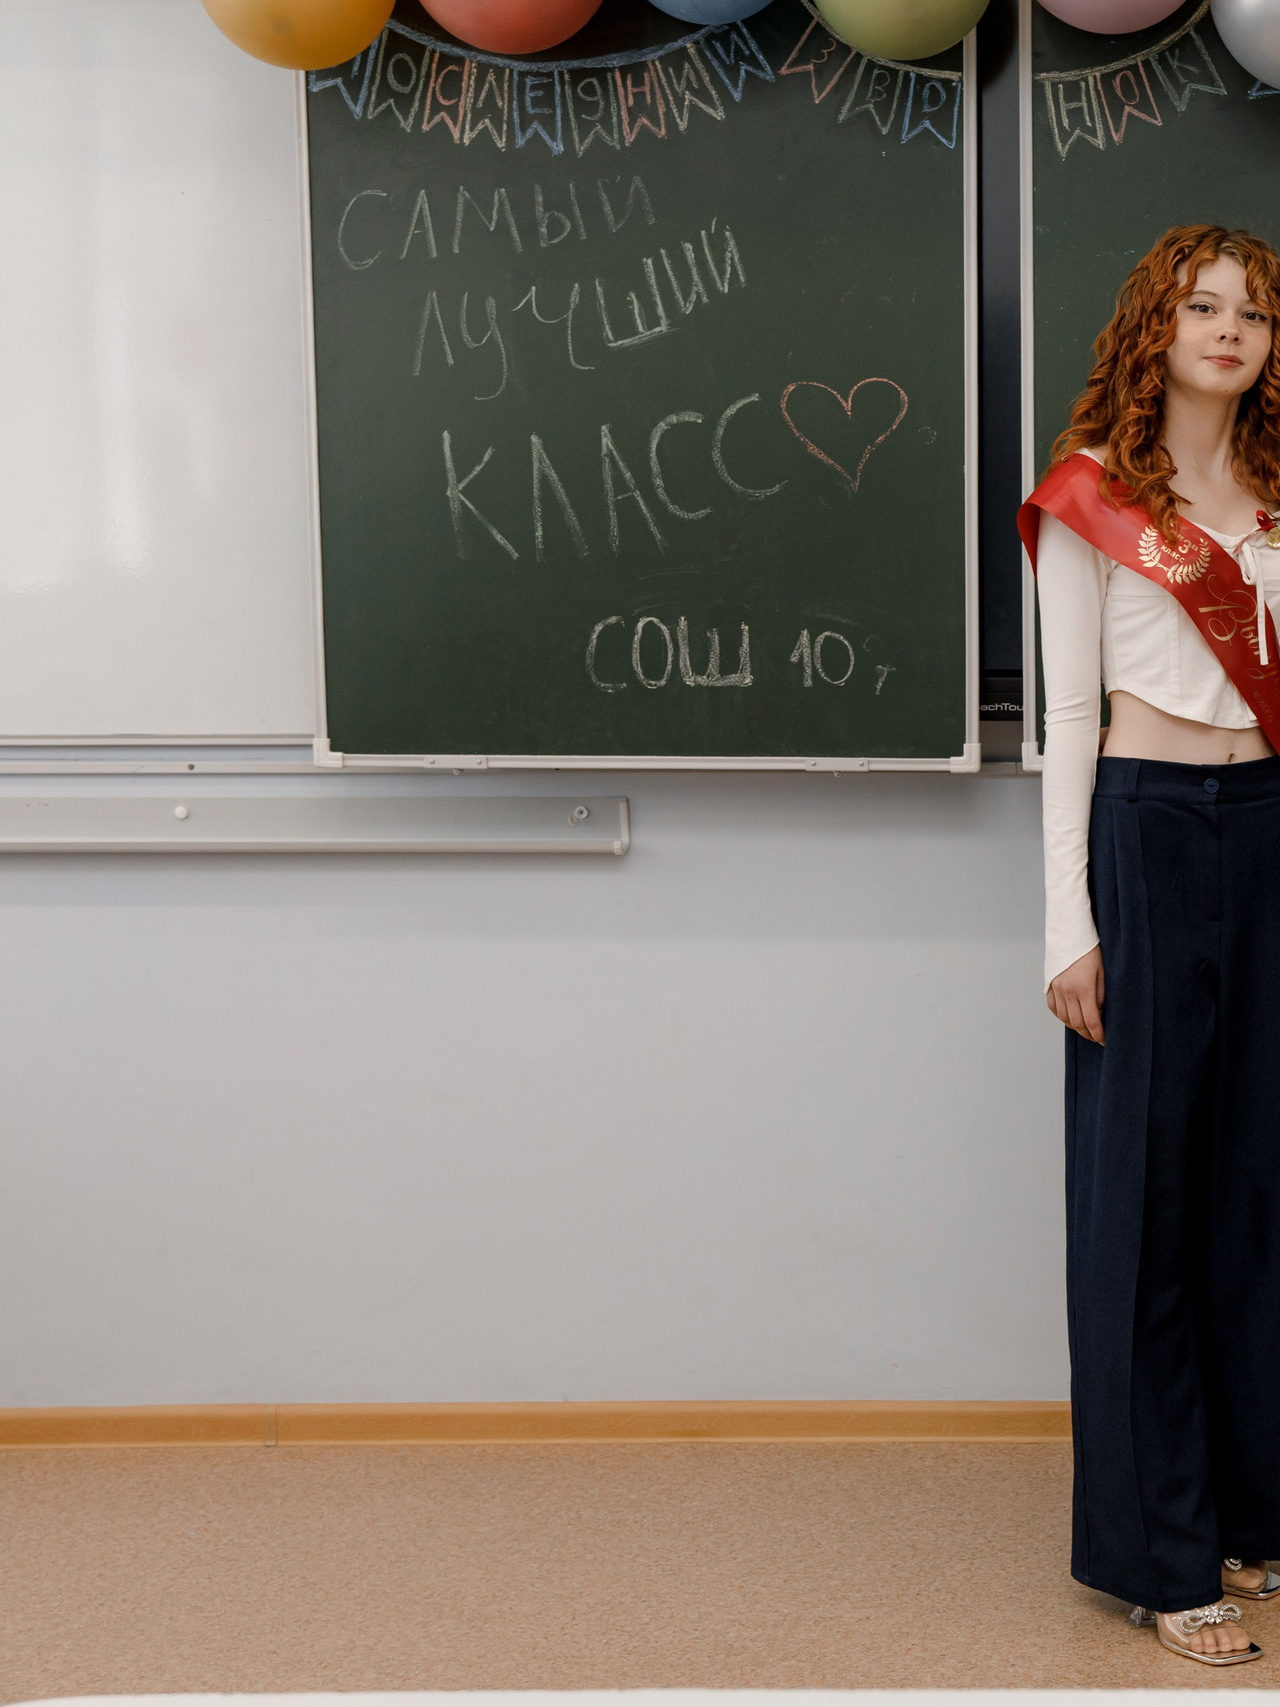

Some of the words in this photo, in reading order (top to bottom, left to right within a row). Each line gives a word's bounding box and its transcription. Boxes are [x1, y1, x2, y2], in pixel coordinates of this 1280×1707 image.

[337, 175, 658, 270] САМЫЙ
[411, 217, 747, 400] ЛУЧШИЙ
[441, 393, 789, 562] КЛАСС
[585, 615, 754, 693] СОШ
